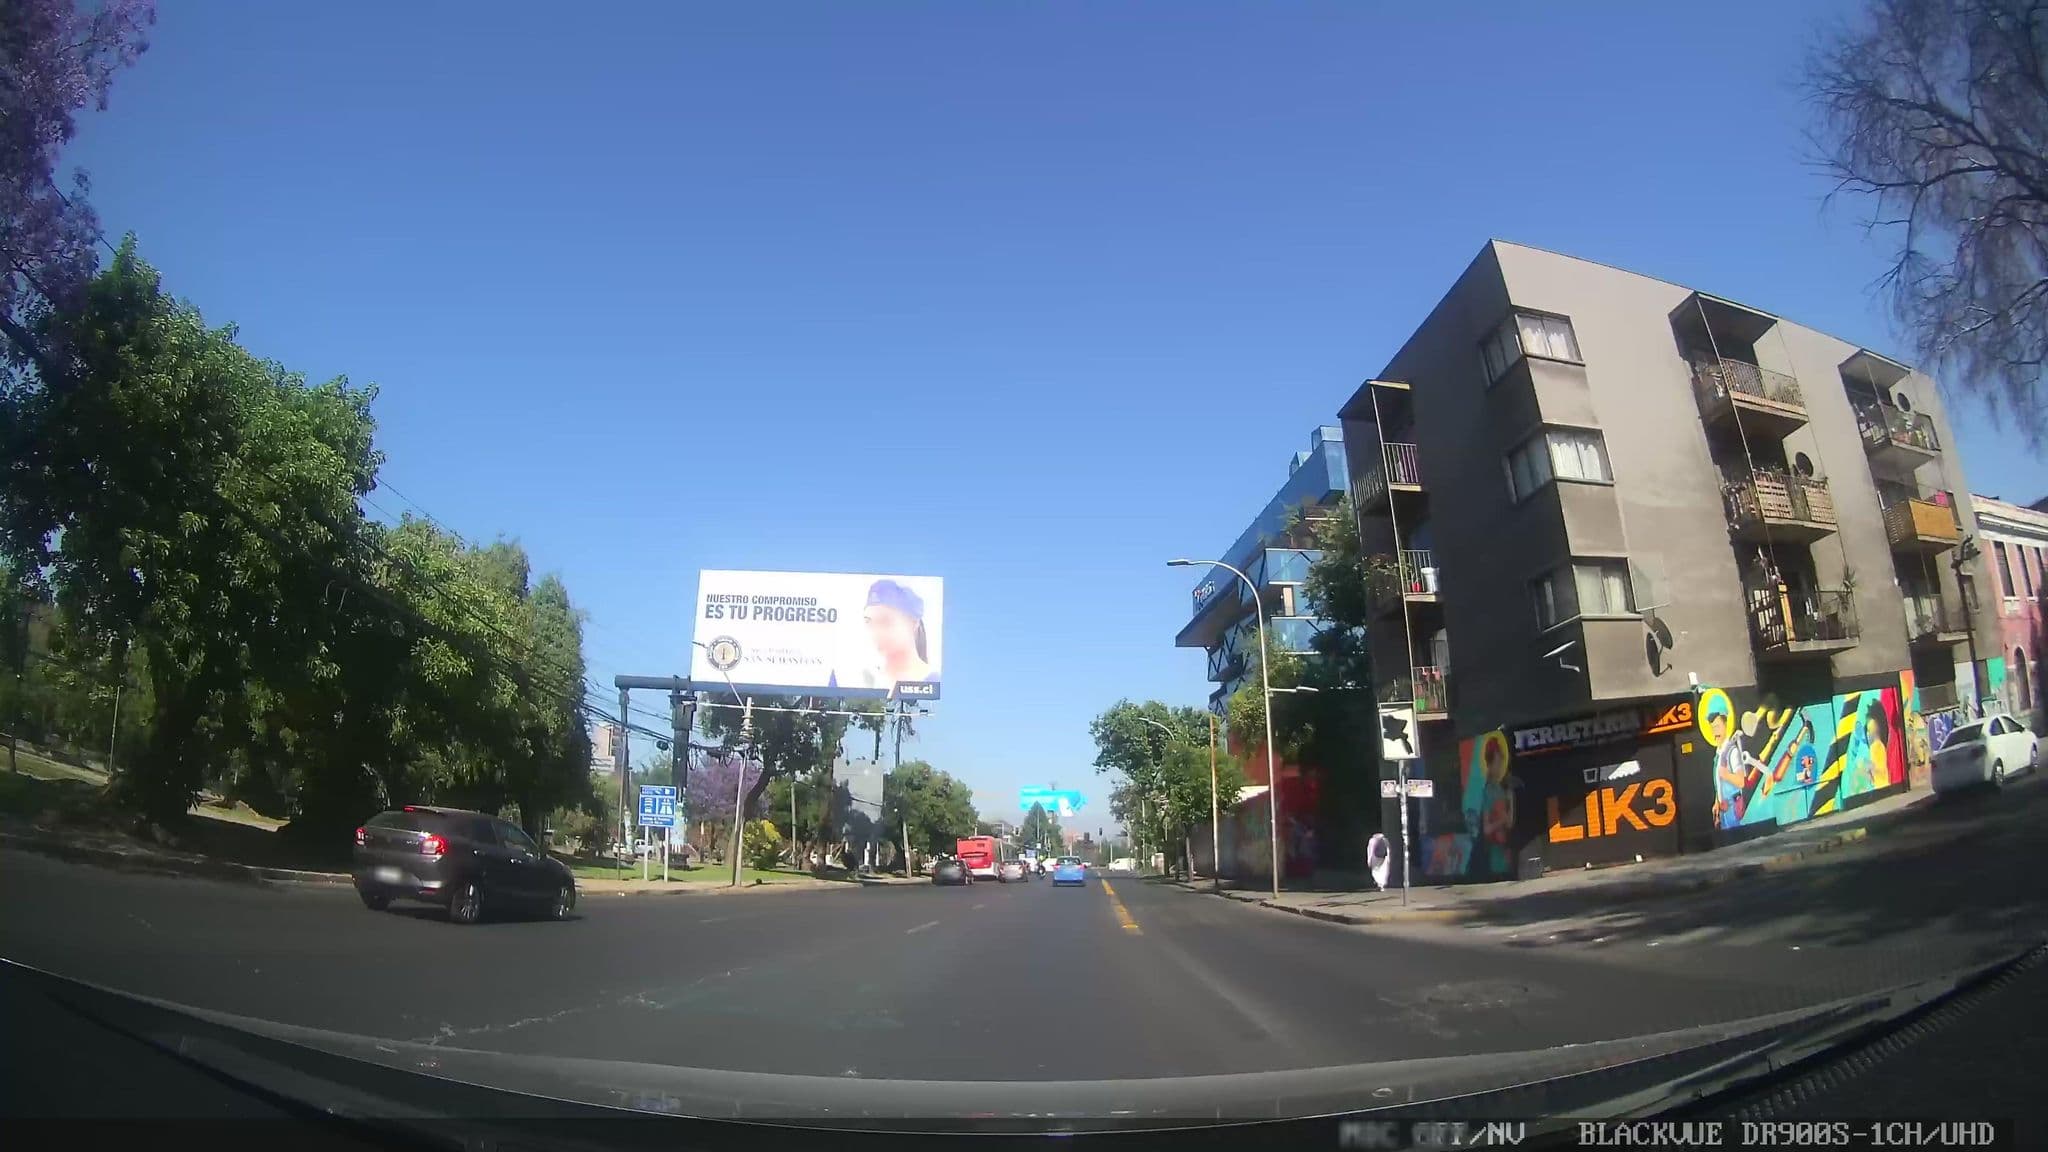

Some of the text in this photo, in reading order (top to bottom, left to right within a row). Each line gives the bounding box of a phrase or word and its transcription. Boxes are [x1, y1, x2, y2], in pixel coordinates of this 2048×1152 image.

[706, 594, 817, 606] NUESTRO COMPROMISO
[705, 604, 838, 623] ES TU PROGRESO
[900, 685, 933, 694] uss.cl
[1548, 779, 1677, 843] LIK3
